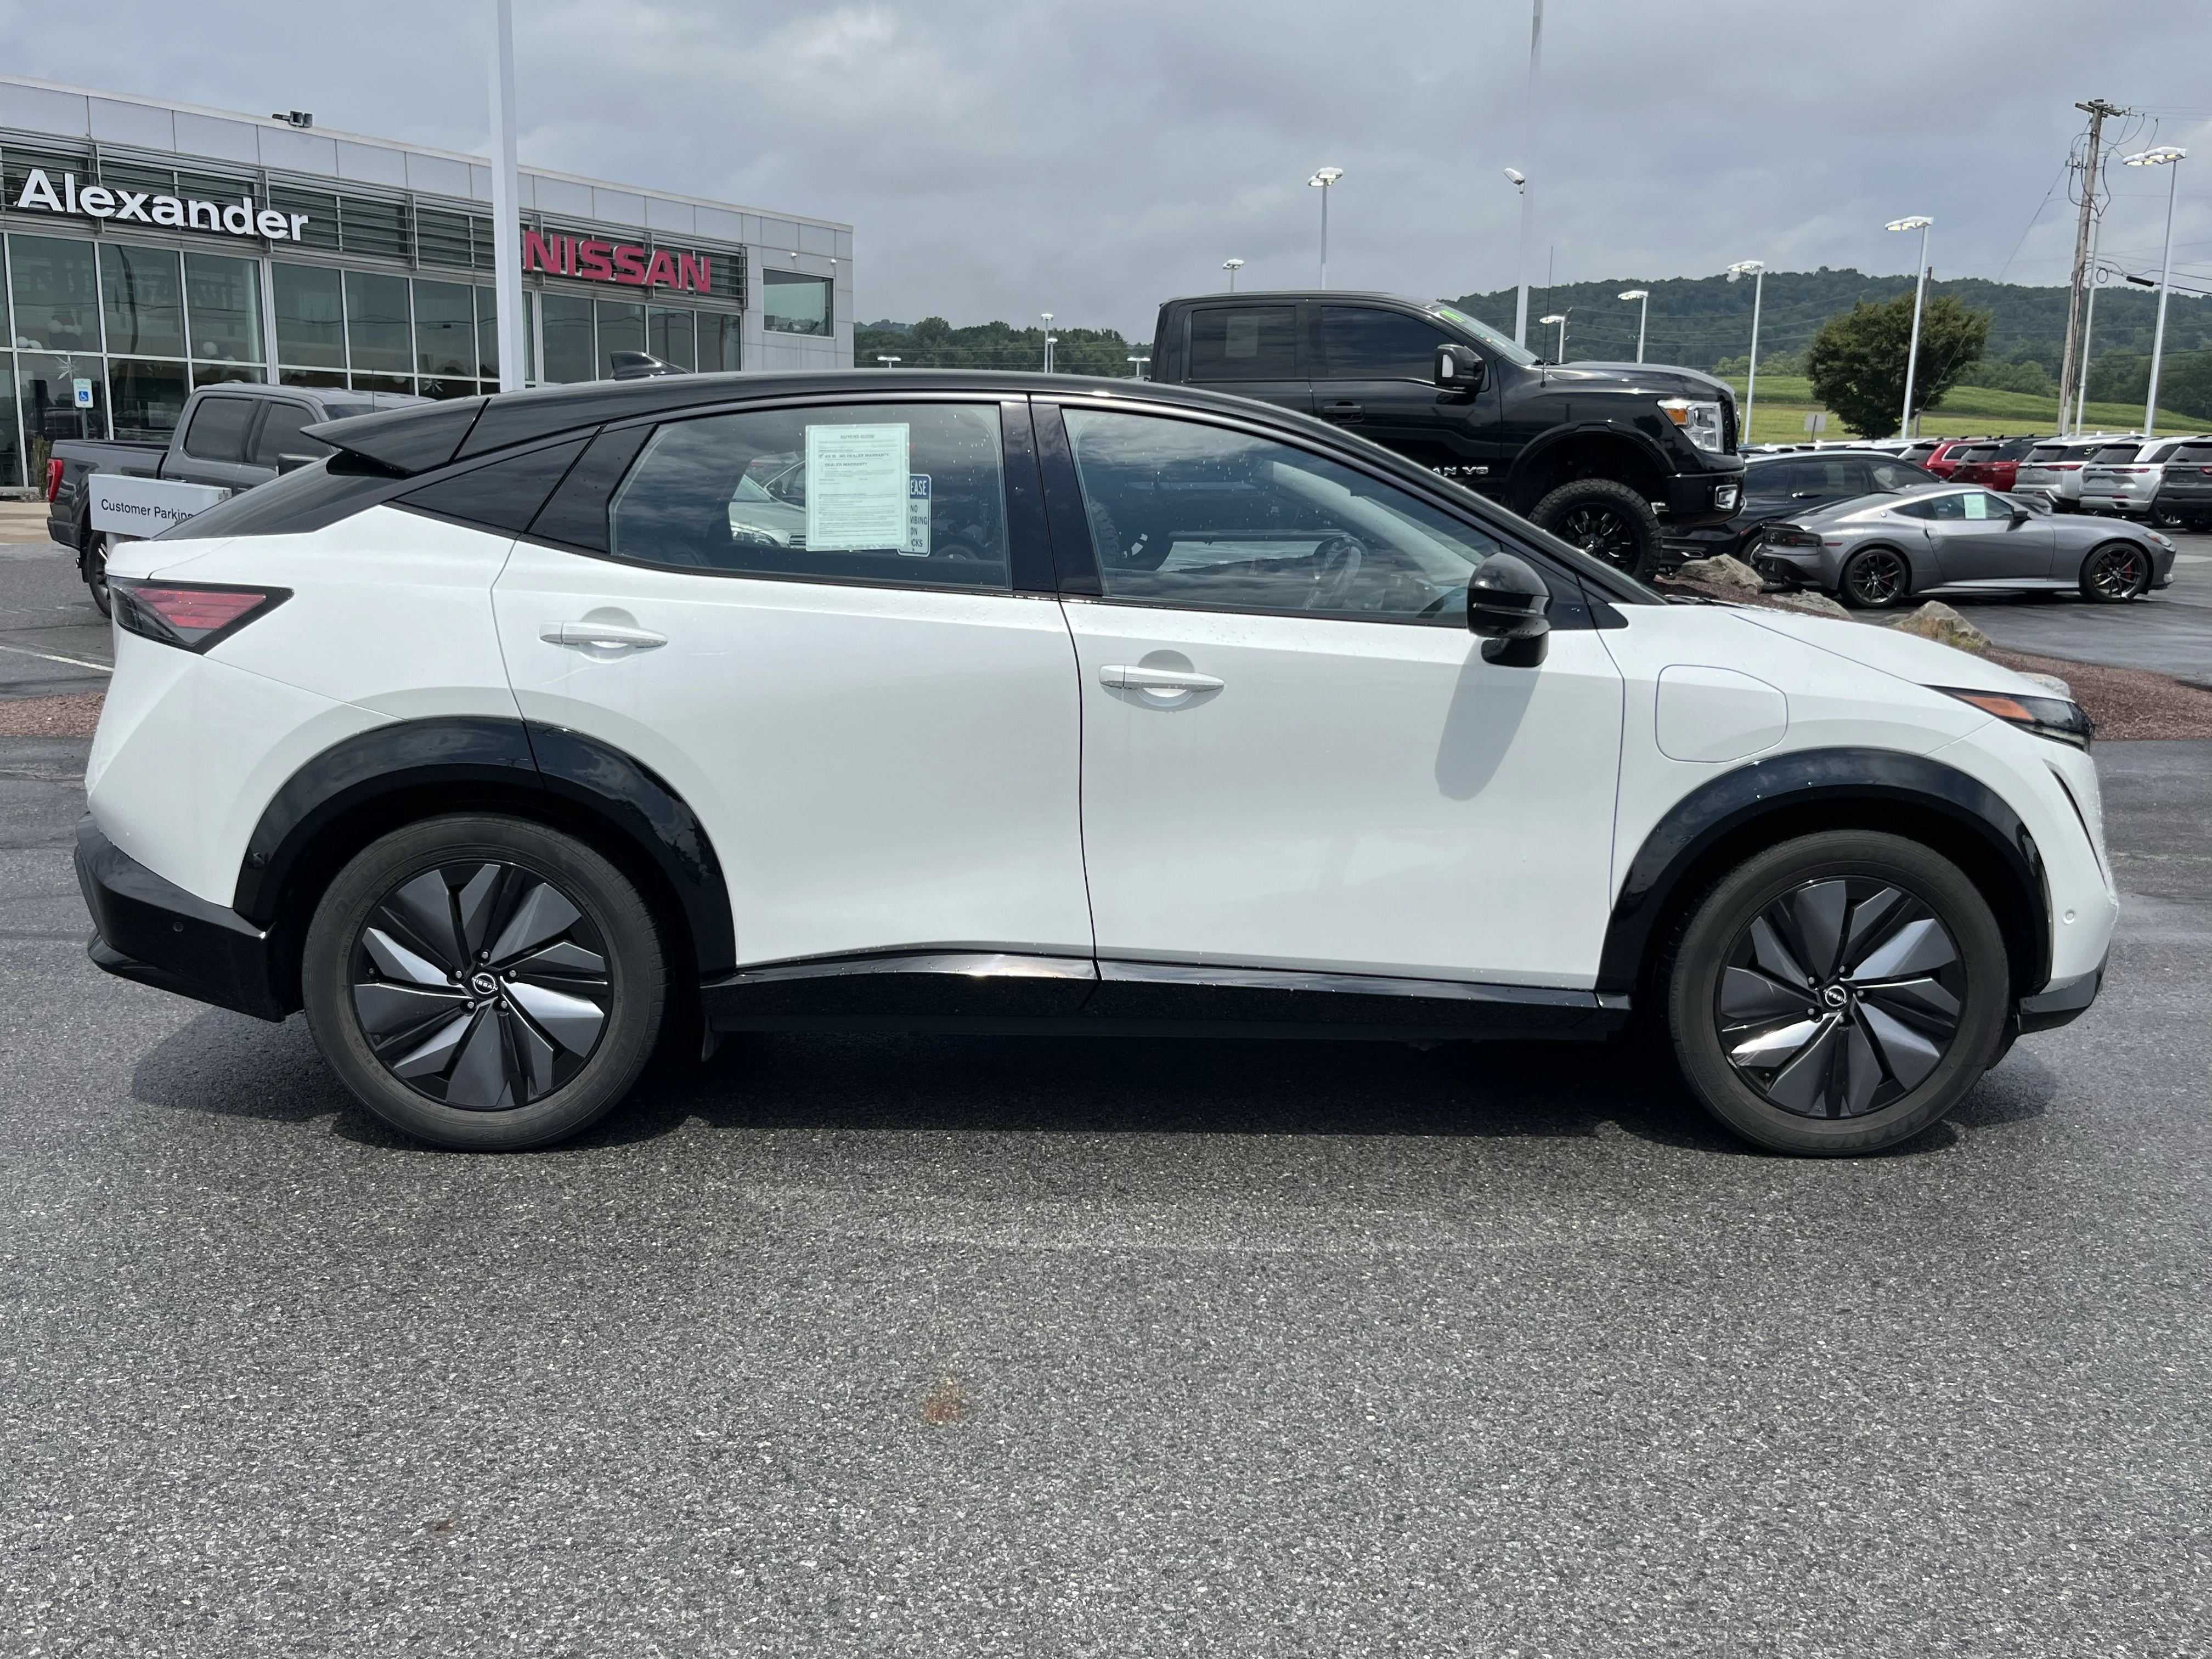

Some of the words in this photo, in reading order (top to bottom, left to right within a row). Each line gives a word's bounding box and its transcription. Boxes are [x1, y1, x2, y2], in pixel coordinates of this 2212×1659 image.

[17, 168, 308, 241] Alexander
[523, 230, 710, 292] NISSAN
[910, 480, 927, 495] EASE
[101, 498, 151, 516] Customer
[910, 504, 918, 513] NO
[910, 527, 918, 535] ON
[911, 539, 923, 547] CKS
[471, 977, 499, 991] NISSAN
